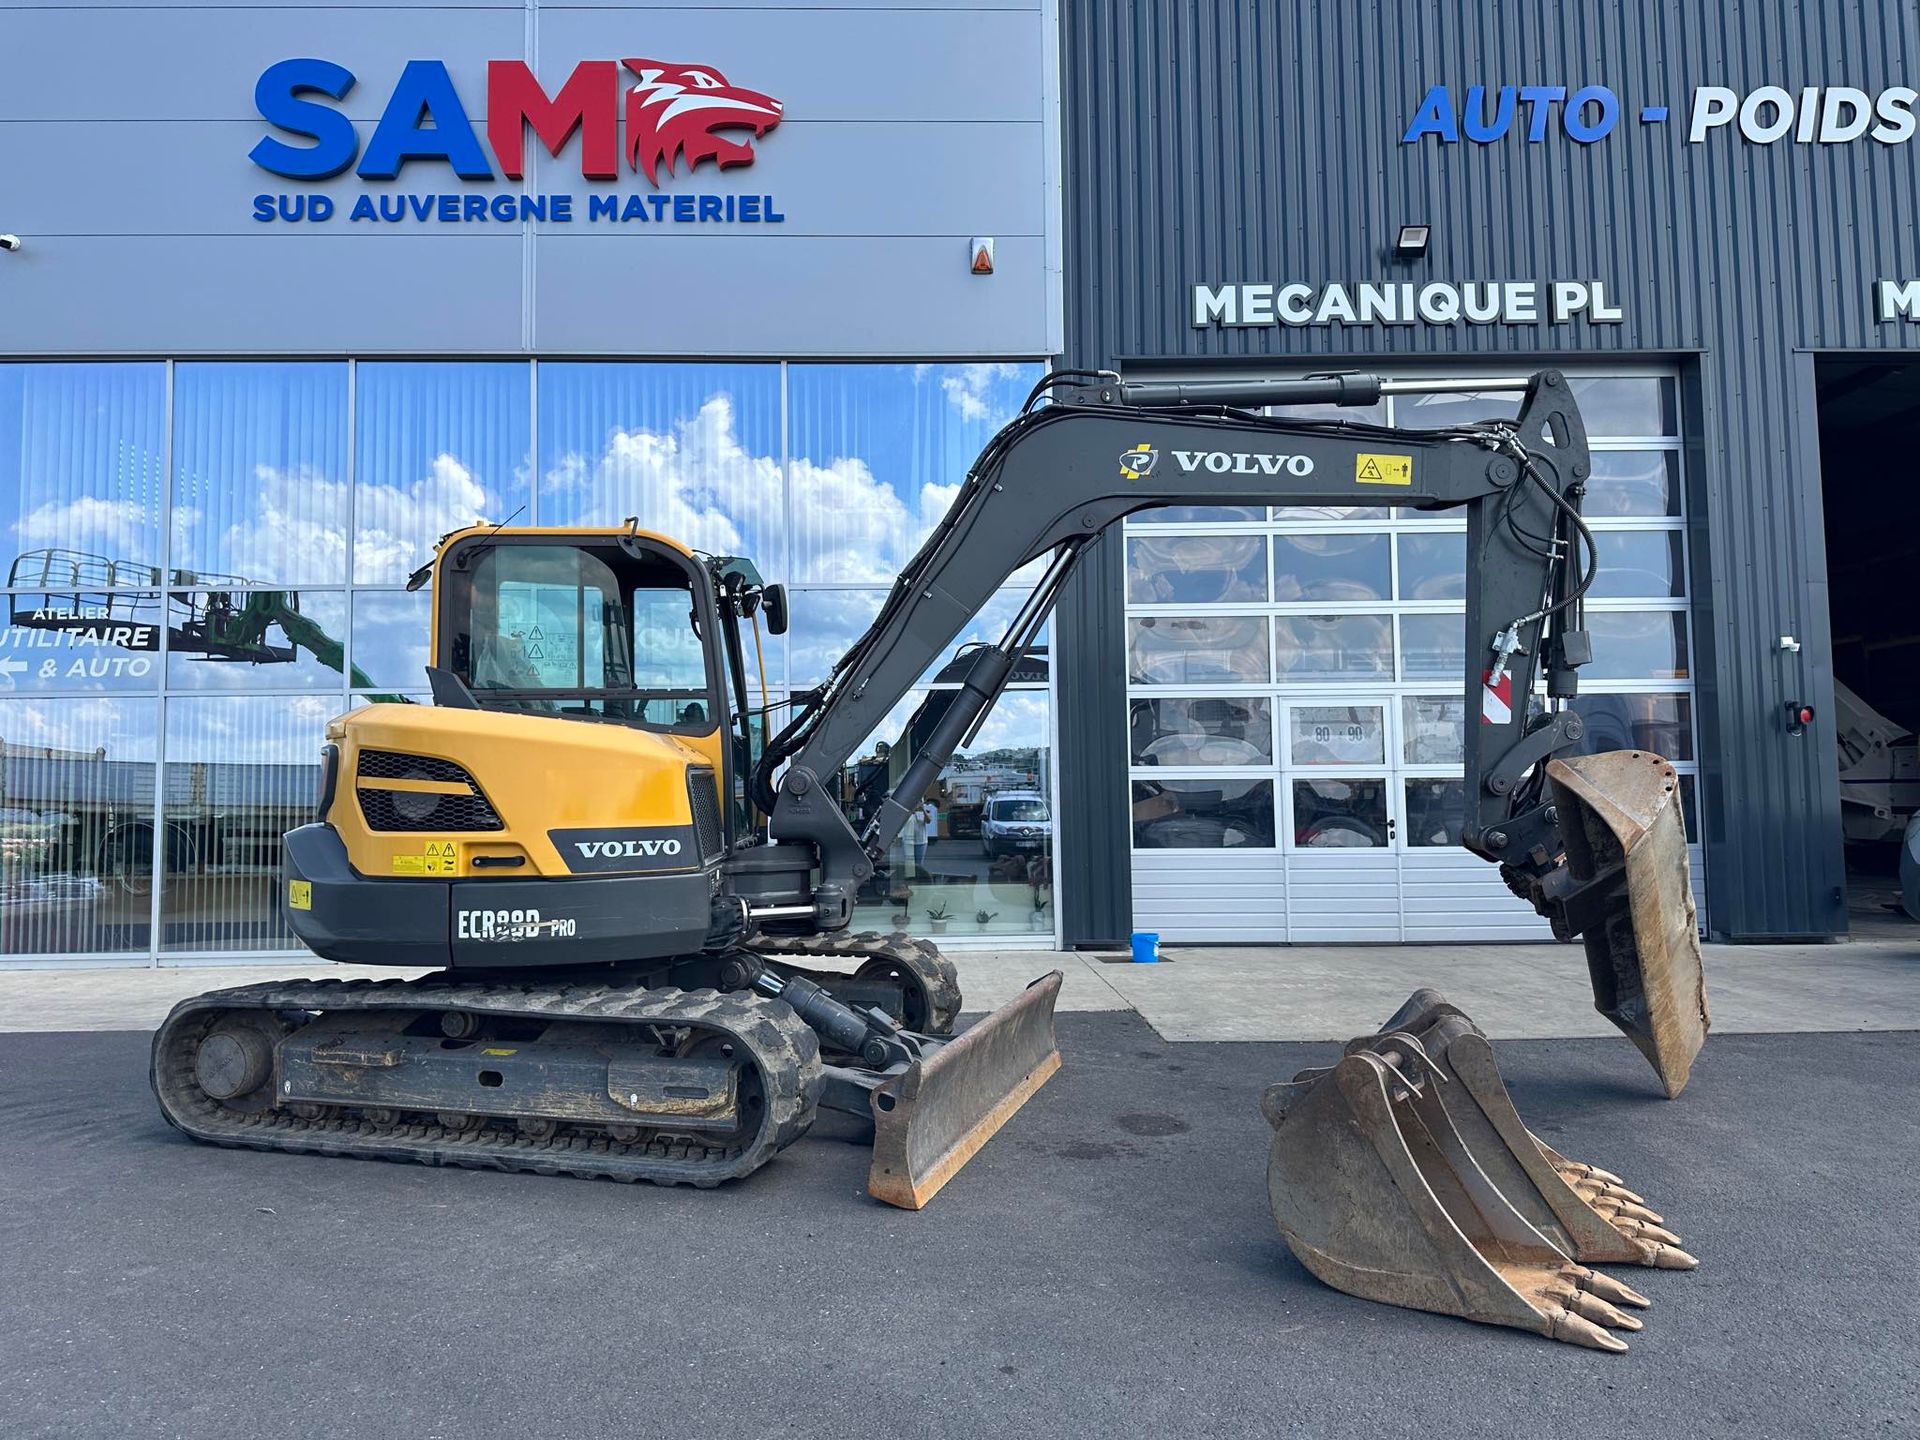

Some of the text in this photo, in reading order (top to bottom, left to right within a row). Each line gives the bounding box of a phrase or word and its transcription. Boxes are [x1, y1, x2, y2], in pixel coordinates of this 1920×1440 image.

[249, 58, 618, 180] SAM
[1403, 86, 1619, 144] AUTO
[1690, 86, 1919, 143] POIDS
[253, 195, 784, 222] SUD AUVERGNE MATERIEL
[1194, 281, 1623, 326] MECANIQUE PL
[1171, 450, 1315, 477] VOLVO
[32, 607, 110, 620] ATELIER
[38, 657, 151, 678] & AUTO
[1315, 726, 1363, 742] 80 90
[575, 839, 682, 859] VOLVO
[551, 918, 576, 937] PRO
